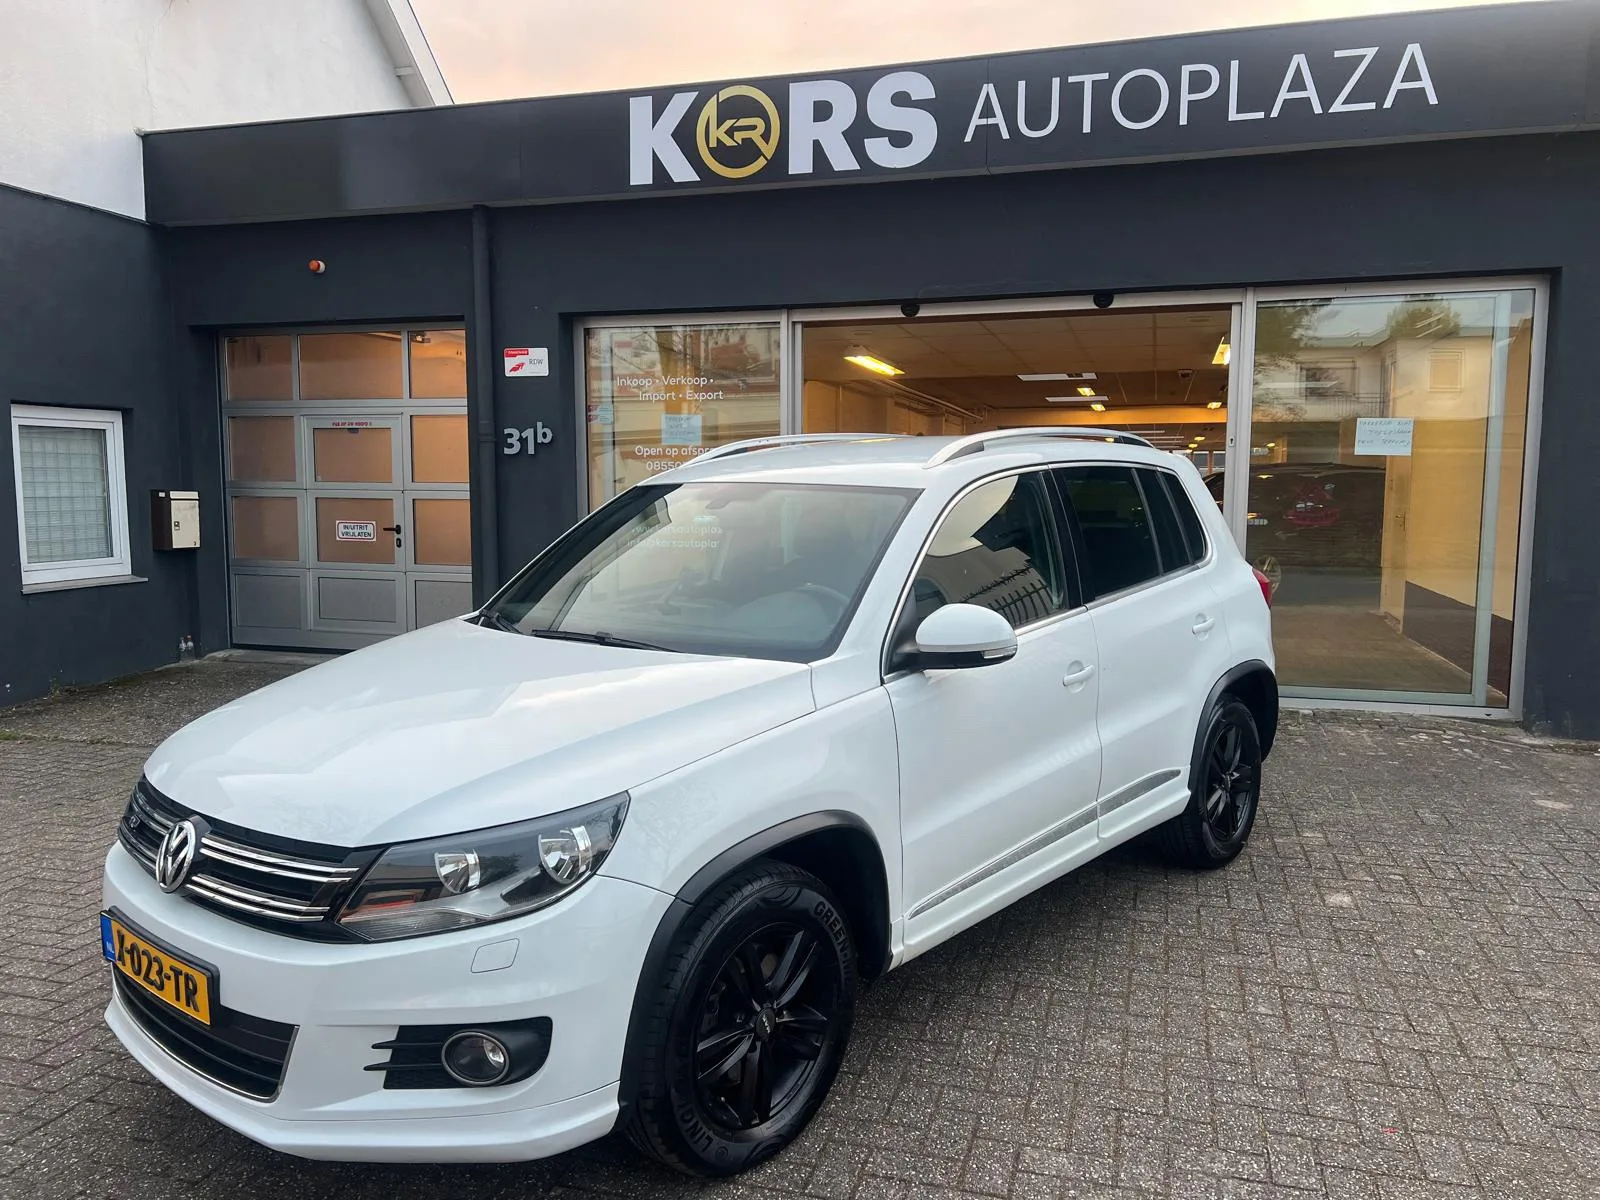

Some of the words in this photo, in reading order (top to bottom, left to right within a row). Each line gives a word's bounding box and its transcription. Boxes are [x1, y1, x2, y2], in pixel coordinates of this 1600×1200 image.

[964, 43, 1438, 142] AUTOPLAZA
[617, 377, 653, 386] Inkoop
[662, 376, 708, 387] Verkoop
[640, 391, 676, 402] Import
[686, 390, 724, 402] Export
[503, 421, 553, 455] 31b
[635, 446, 663, 457] Open
[666, 447, 679, 457] op
[115, 929, 201, 1013] X-023-TR
